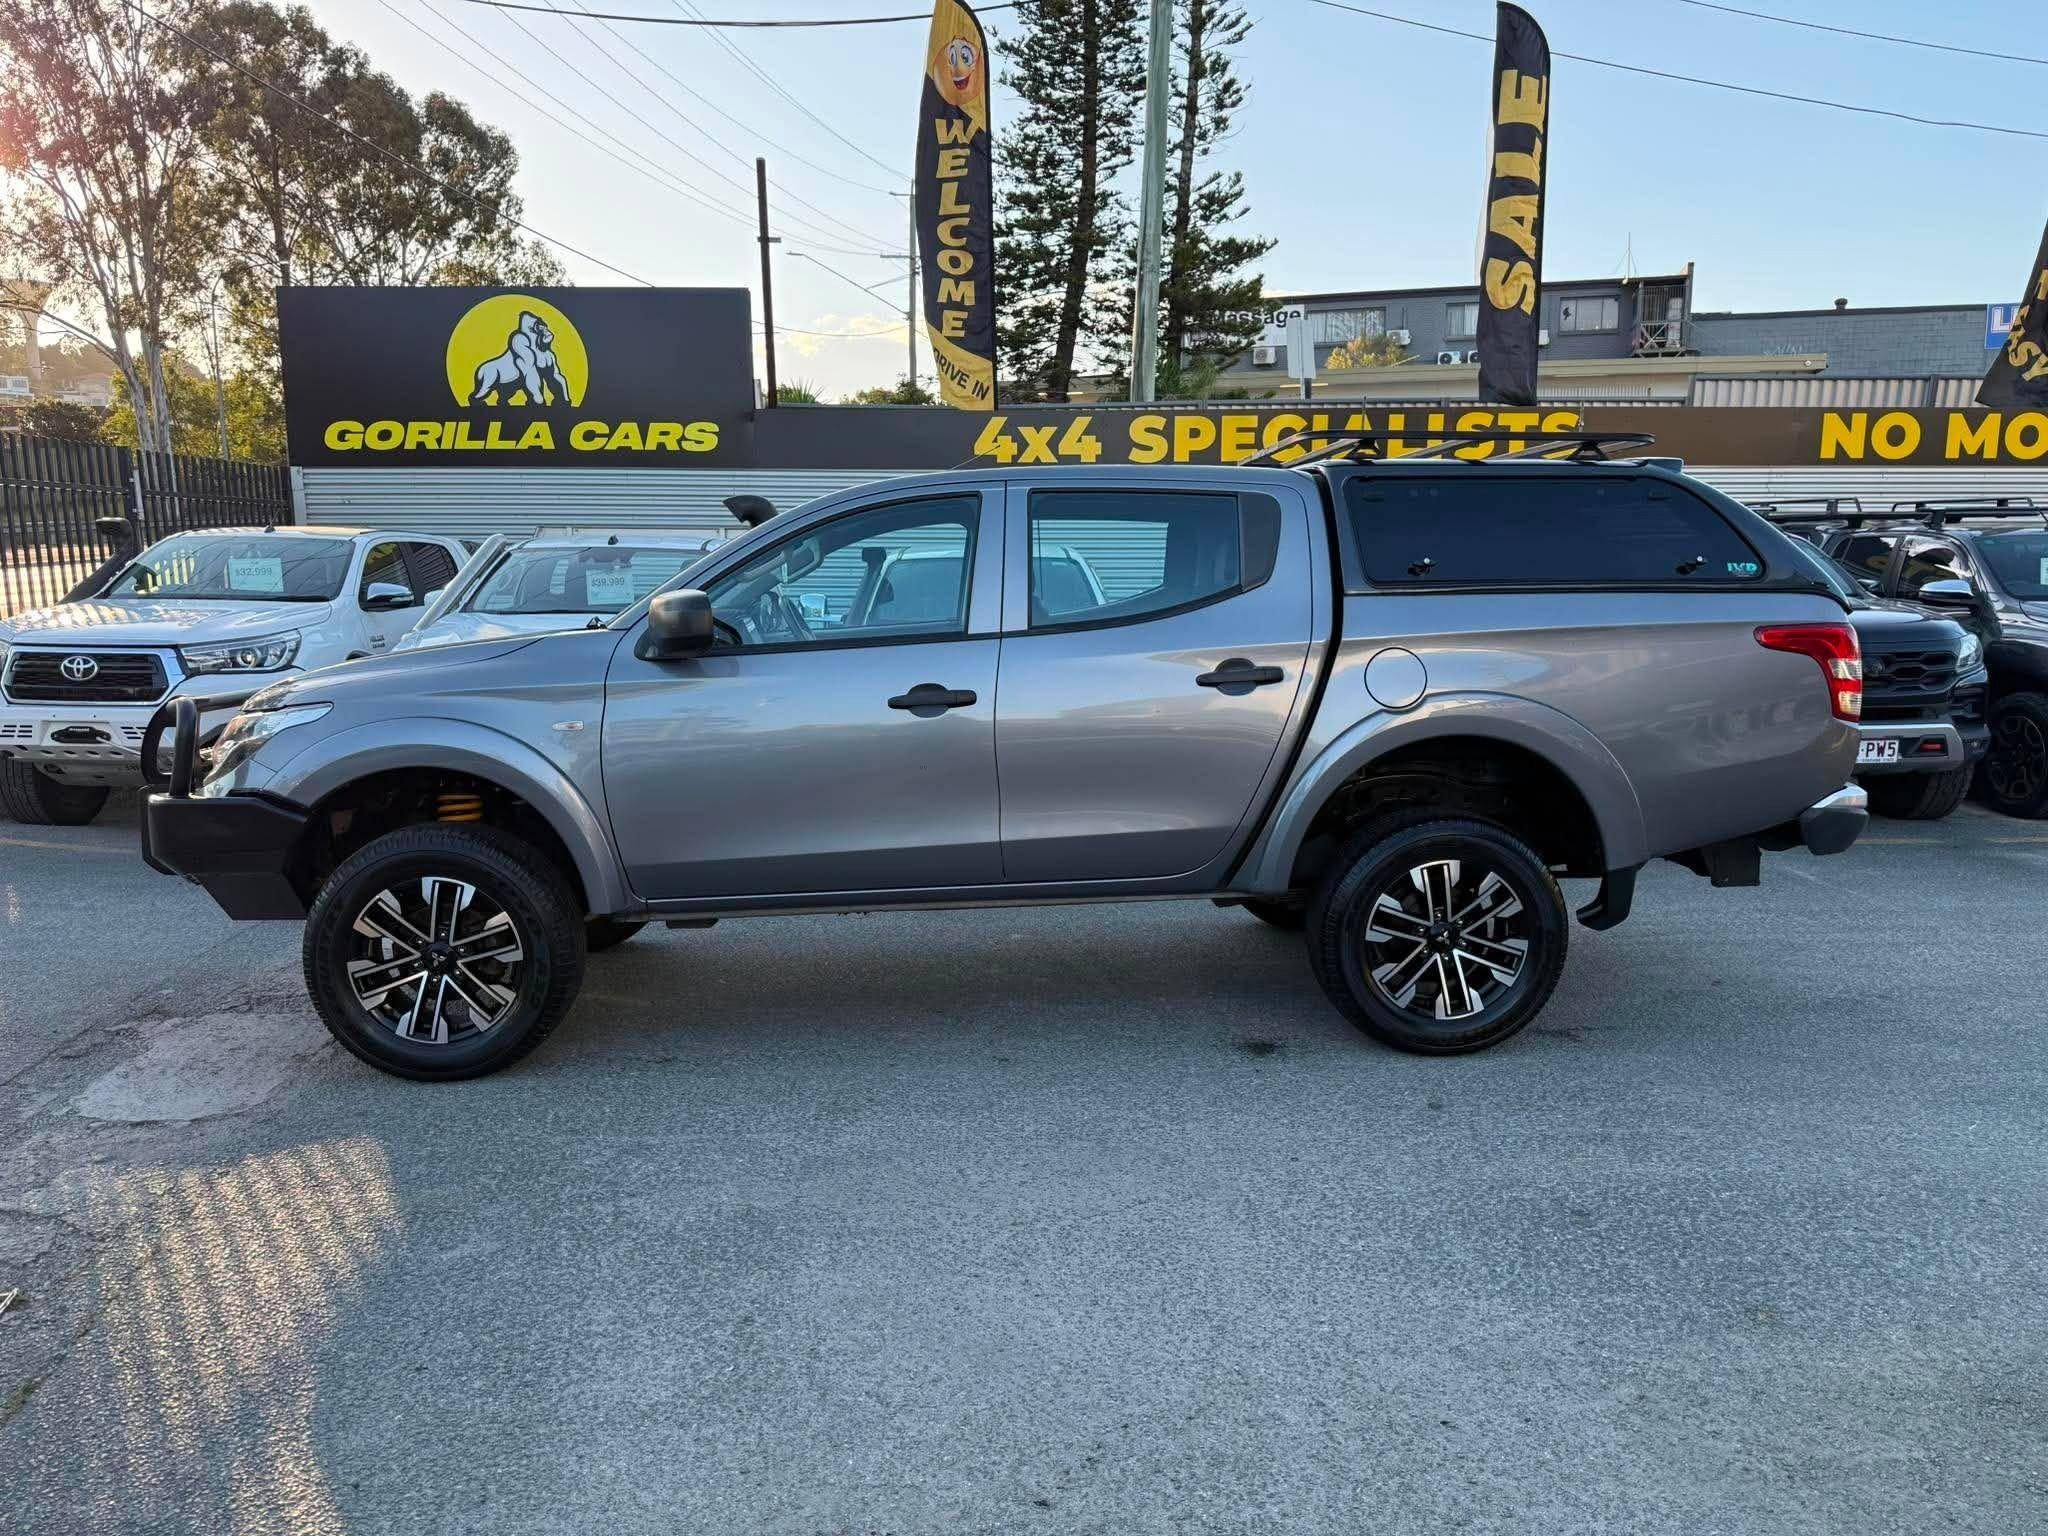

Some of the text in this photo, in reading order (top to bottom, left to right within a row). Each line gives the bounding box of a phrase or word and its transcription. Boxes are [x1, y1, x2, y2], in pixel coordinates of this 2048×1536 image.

[1486, 69, 1547, 315] SALE
[935, 118, 976, 338] WELCOME
[933, 347, 990, 401] DRIVE IN
[324, 420, 719, 452] GORILLA CARS
[974, 411, 1581, 465] 4x4 SPECIALISTS
[1820, 412, 2048, 460] NO MO
